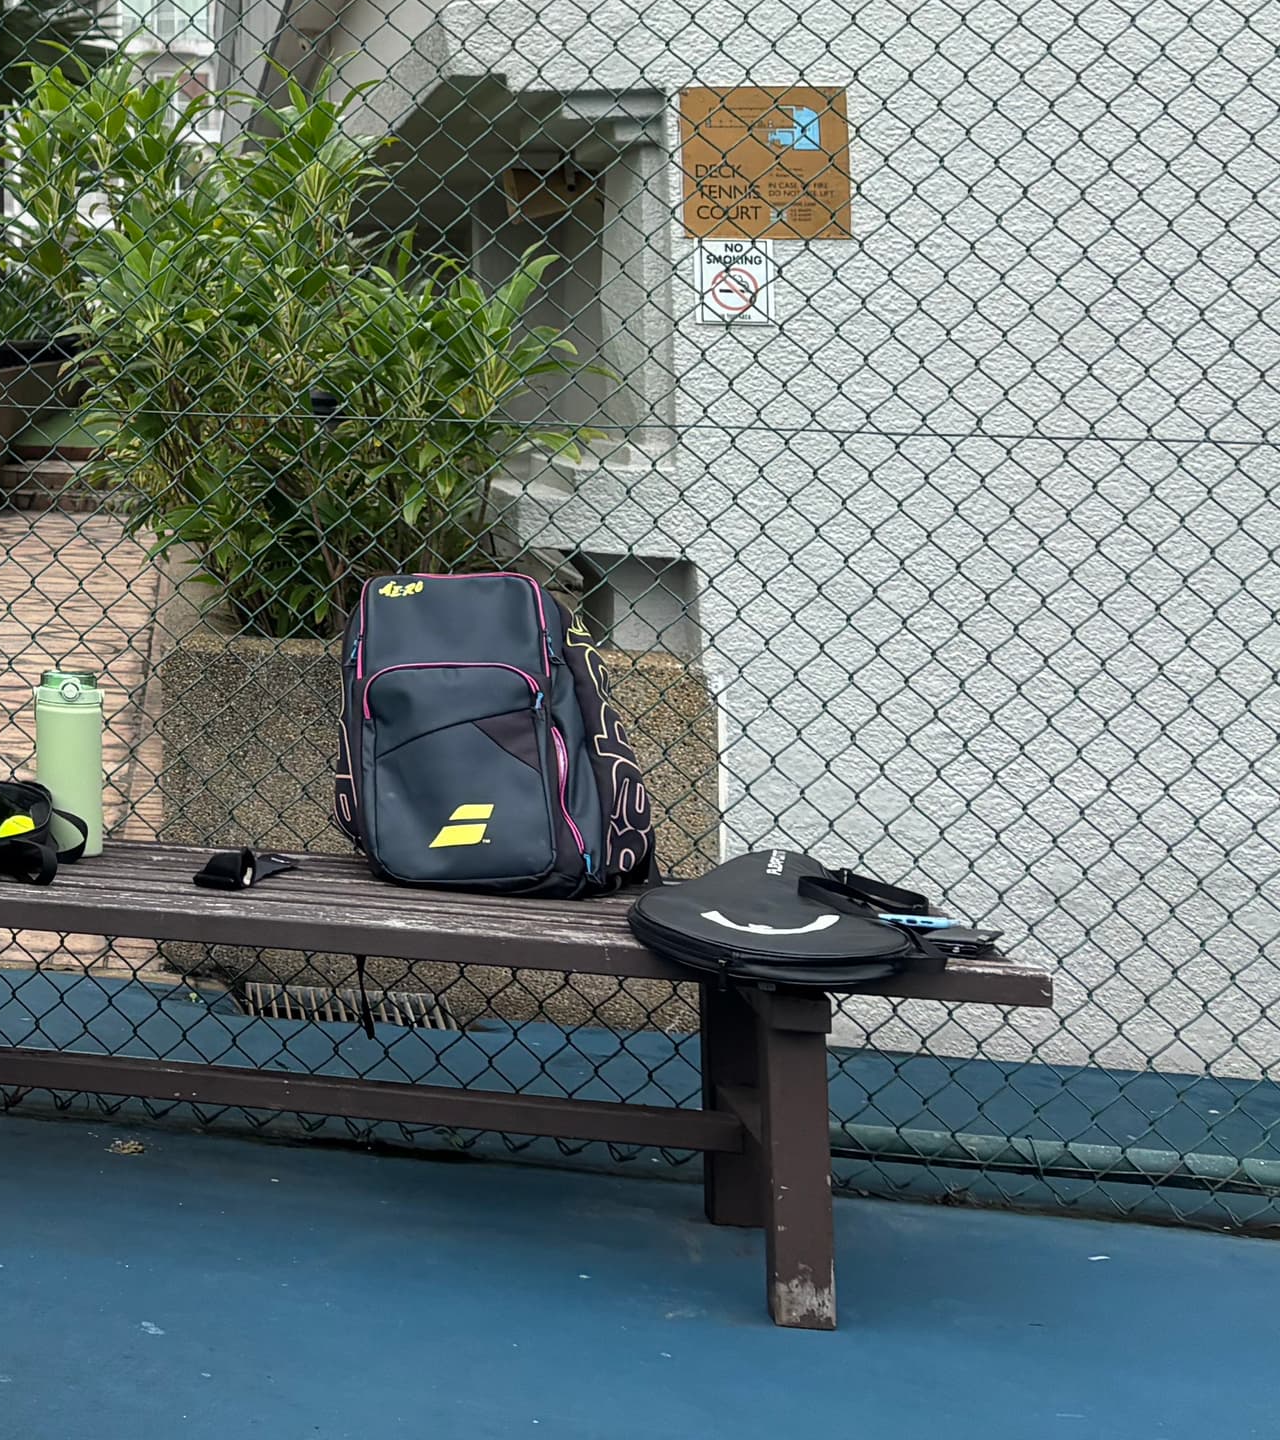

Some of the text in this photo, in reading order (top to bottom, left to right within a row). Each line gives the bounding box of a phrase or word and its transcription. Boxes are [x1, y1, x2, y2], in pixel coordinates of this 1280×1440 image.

[695, 163, 743, 179] DECK
[699, 184, 760, 199] TENNIS
[696, 204, 762, 220] COURT
[724, 243, 744, 253] NO
[706, 254, 762, 265] SMOKING
